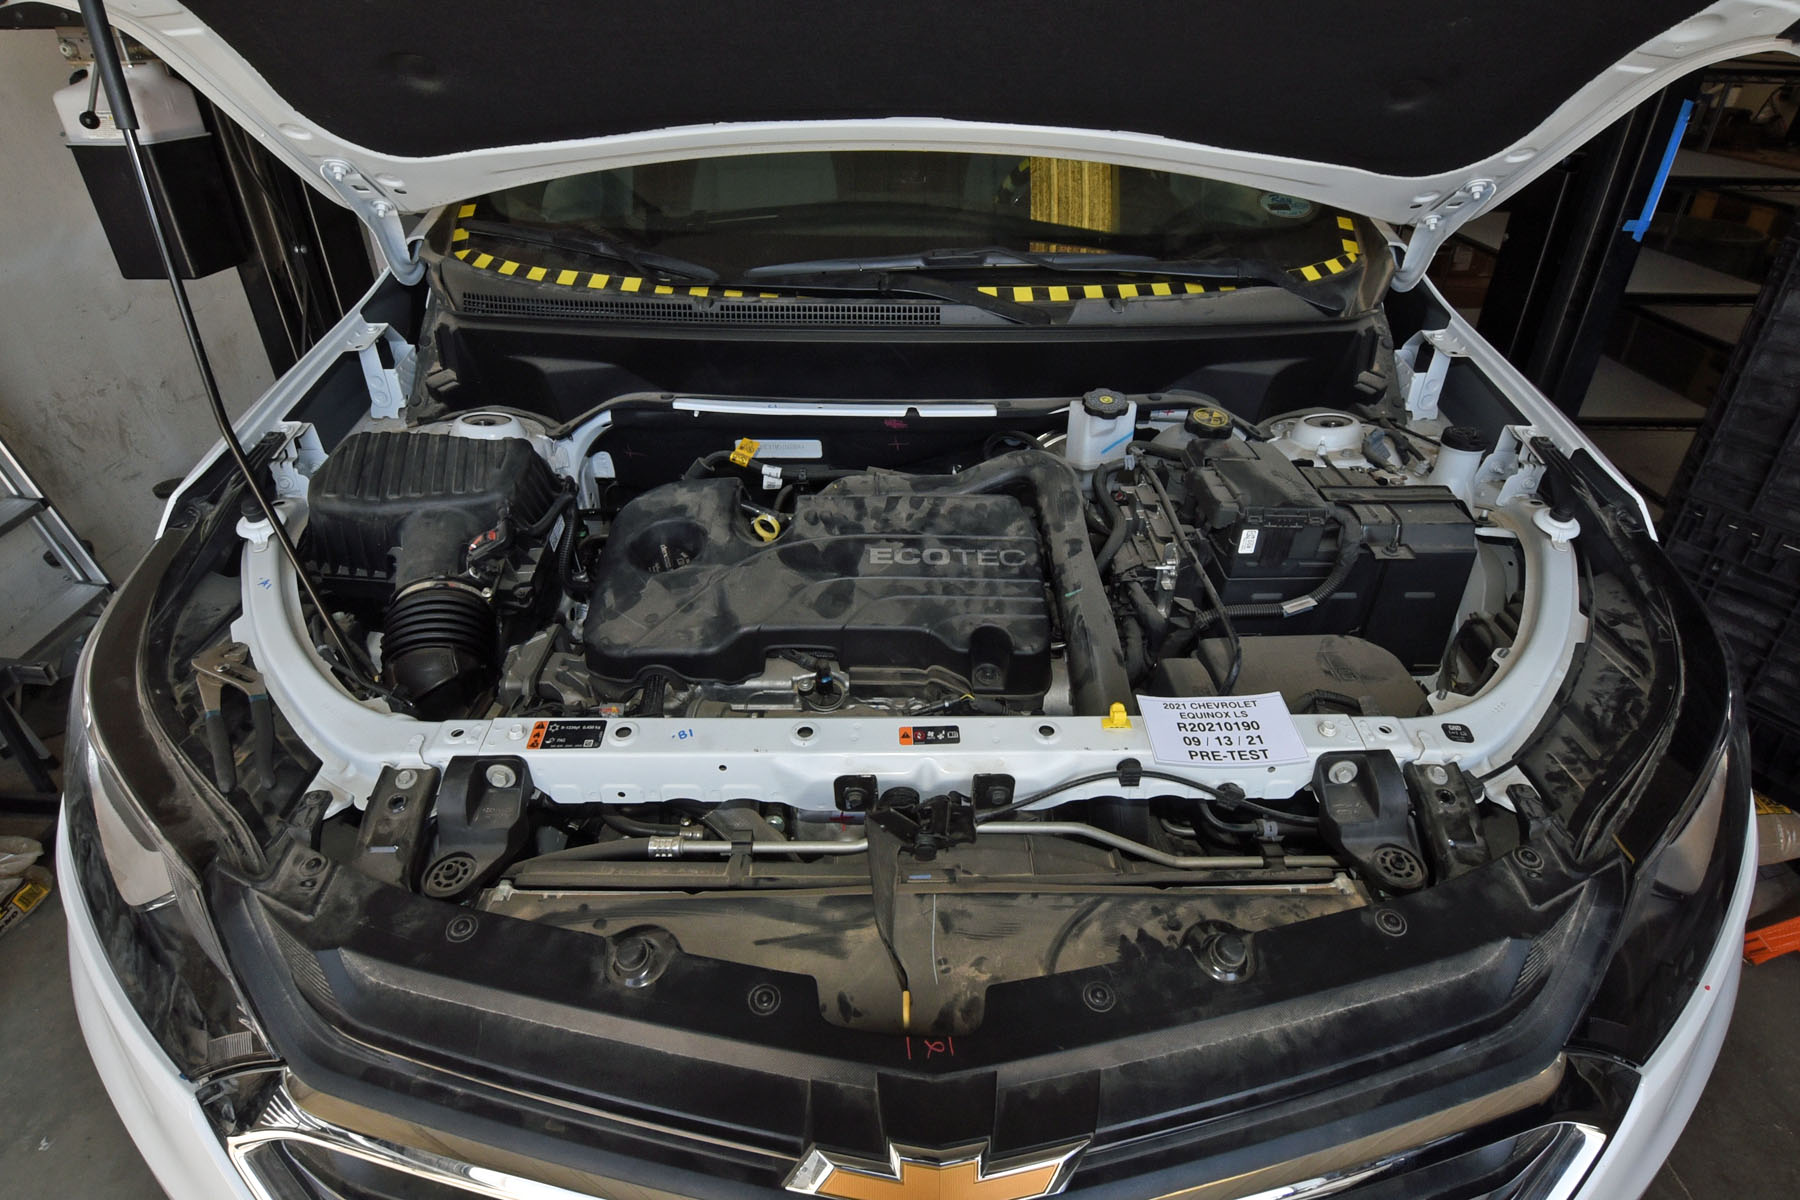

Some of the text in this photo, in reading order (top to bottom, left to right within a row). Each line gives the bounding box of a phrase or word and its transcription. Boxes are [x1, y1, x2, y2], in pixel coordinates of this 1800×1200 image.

[869, 548, 1027, 566] ECOTEC
[1163, 700, 1258, 710] 2021 CHEVROLET
[1179, 711, 1231, 720] EQUINOX
[1177, 720, 1260, 732] R20210190
[1183, 736, 1201, 746] 09
[1215, 736, 1233, 746] 13
[1246, 734, 1264, 745] 21
[1188, 749, 1270, 761] PRE-TEST
